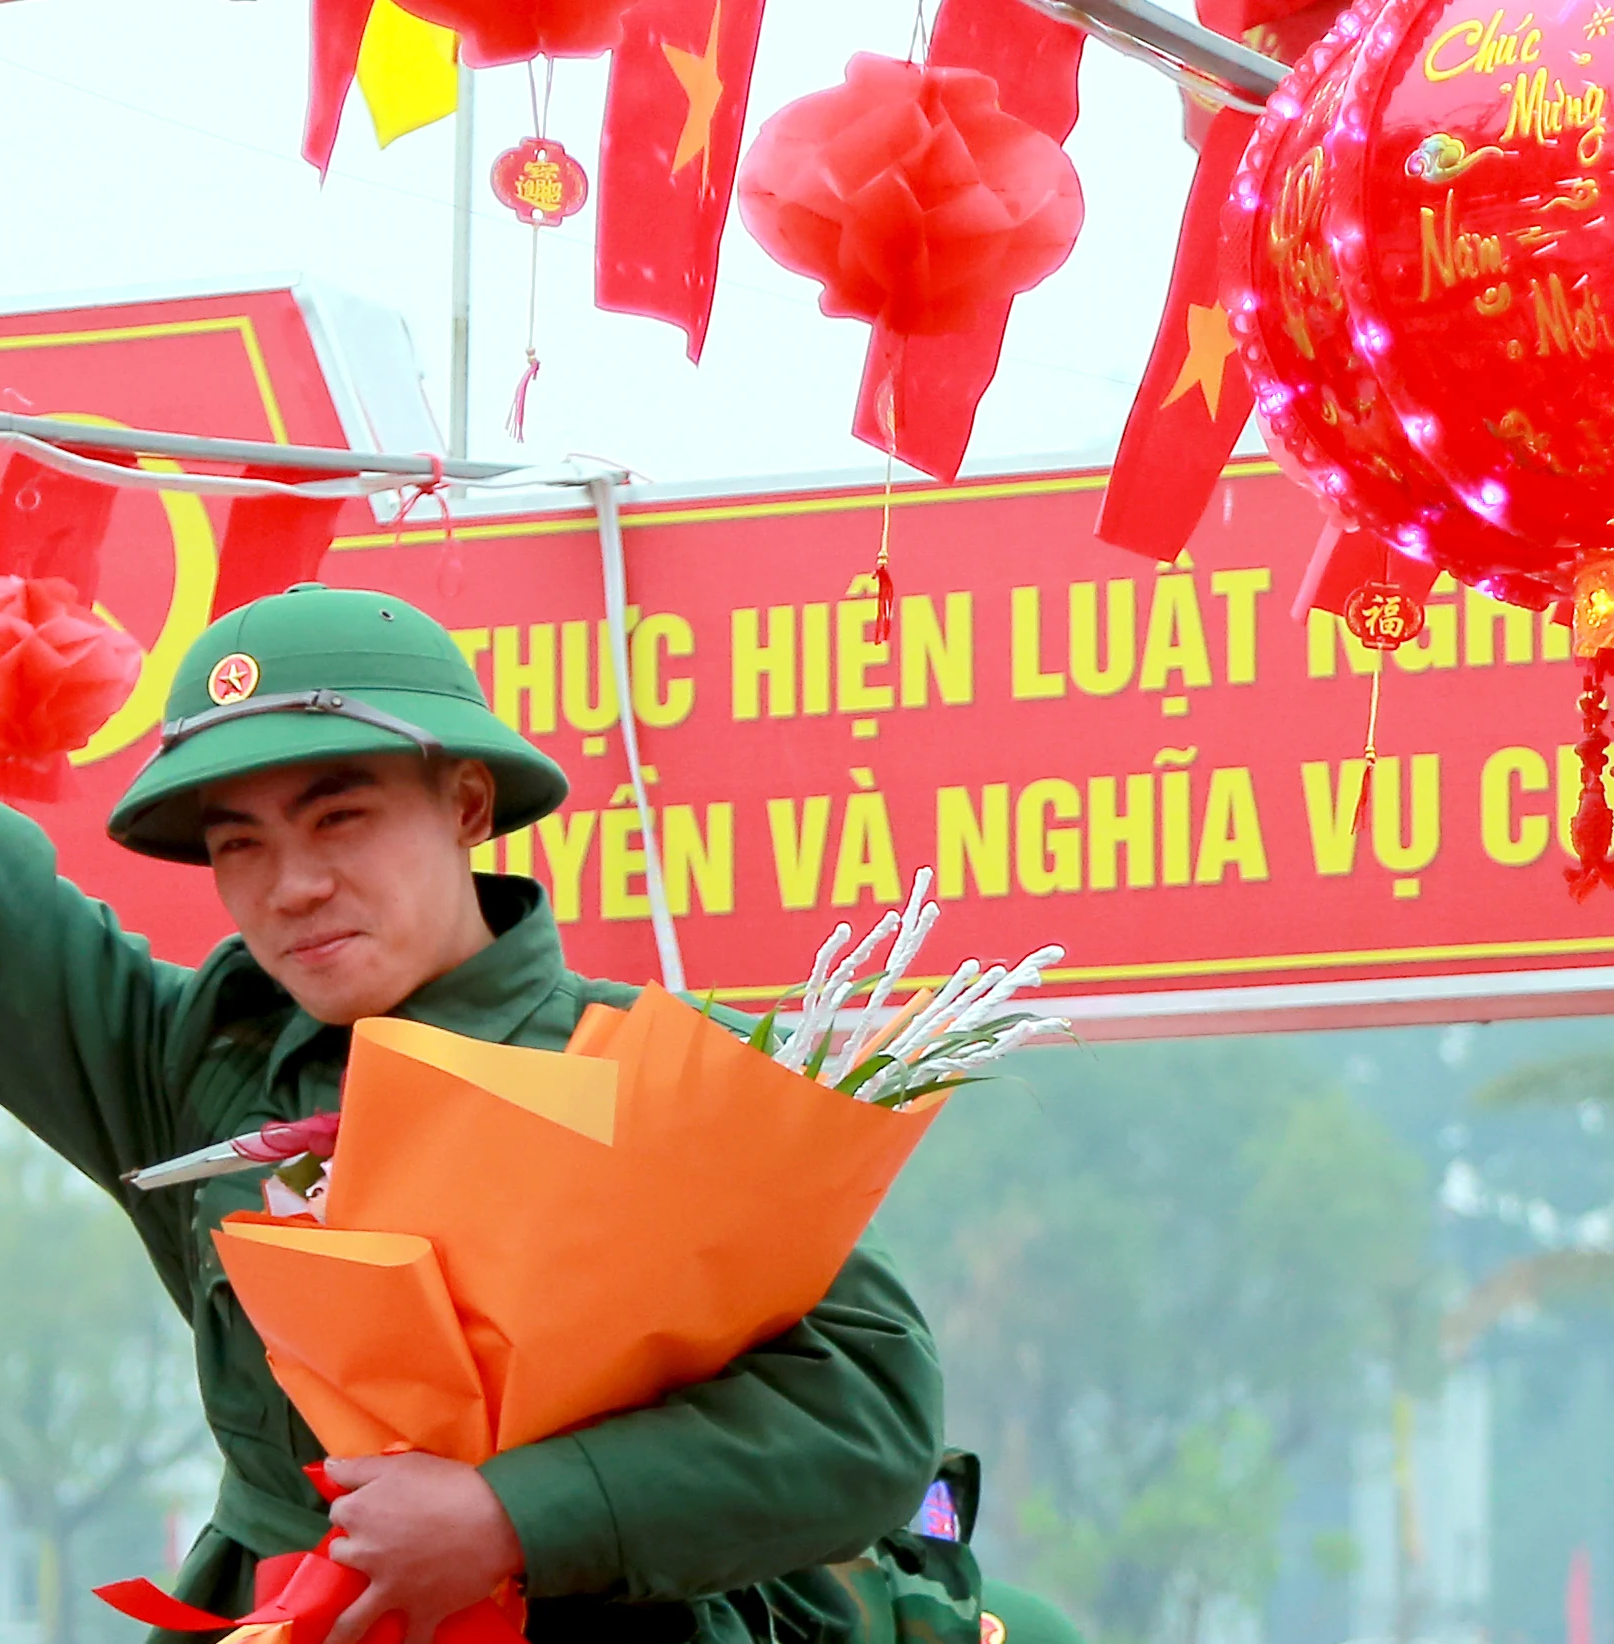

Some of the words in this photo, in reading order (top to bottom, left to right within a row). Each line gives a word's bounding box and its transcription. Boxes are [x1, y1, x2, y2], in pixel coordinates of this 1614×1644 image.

[731, 570, 999, 738] HIỆN
[1010, 549, 1273, 717] LUẬT
[1362, 593, 1405, 638] 福
[470, 765, 734, 924] YỀN
[766, 767, 903, 911] VÀ
[934, 744, 1270, 901] NGHĨA
[1301, 752, 1443, 897] VỤ
